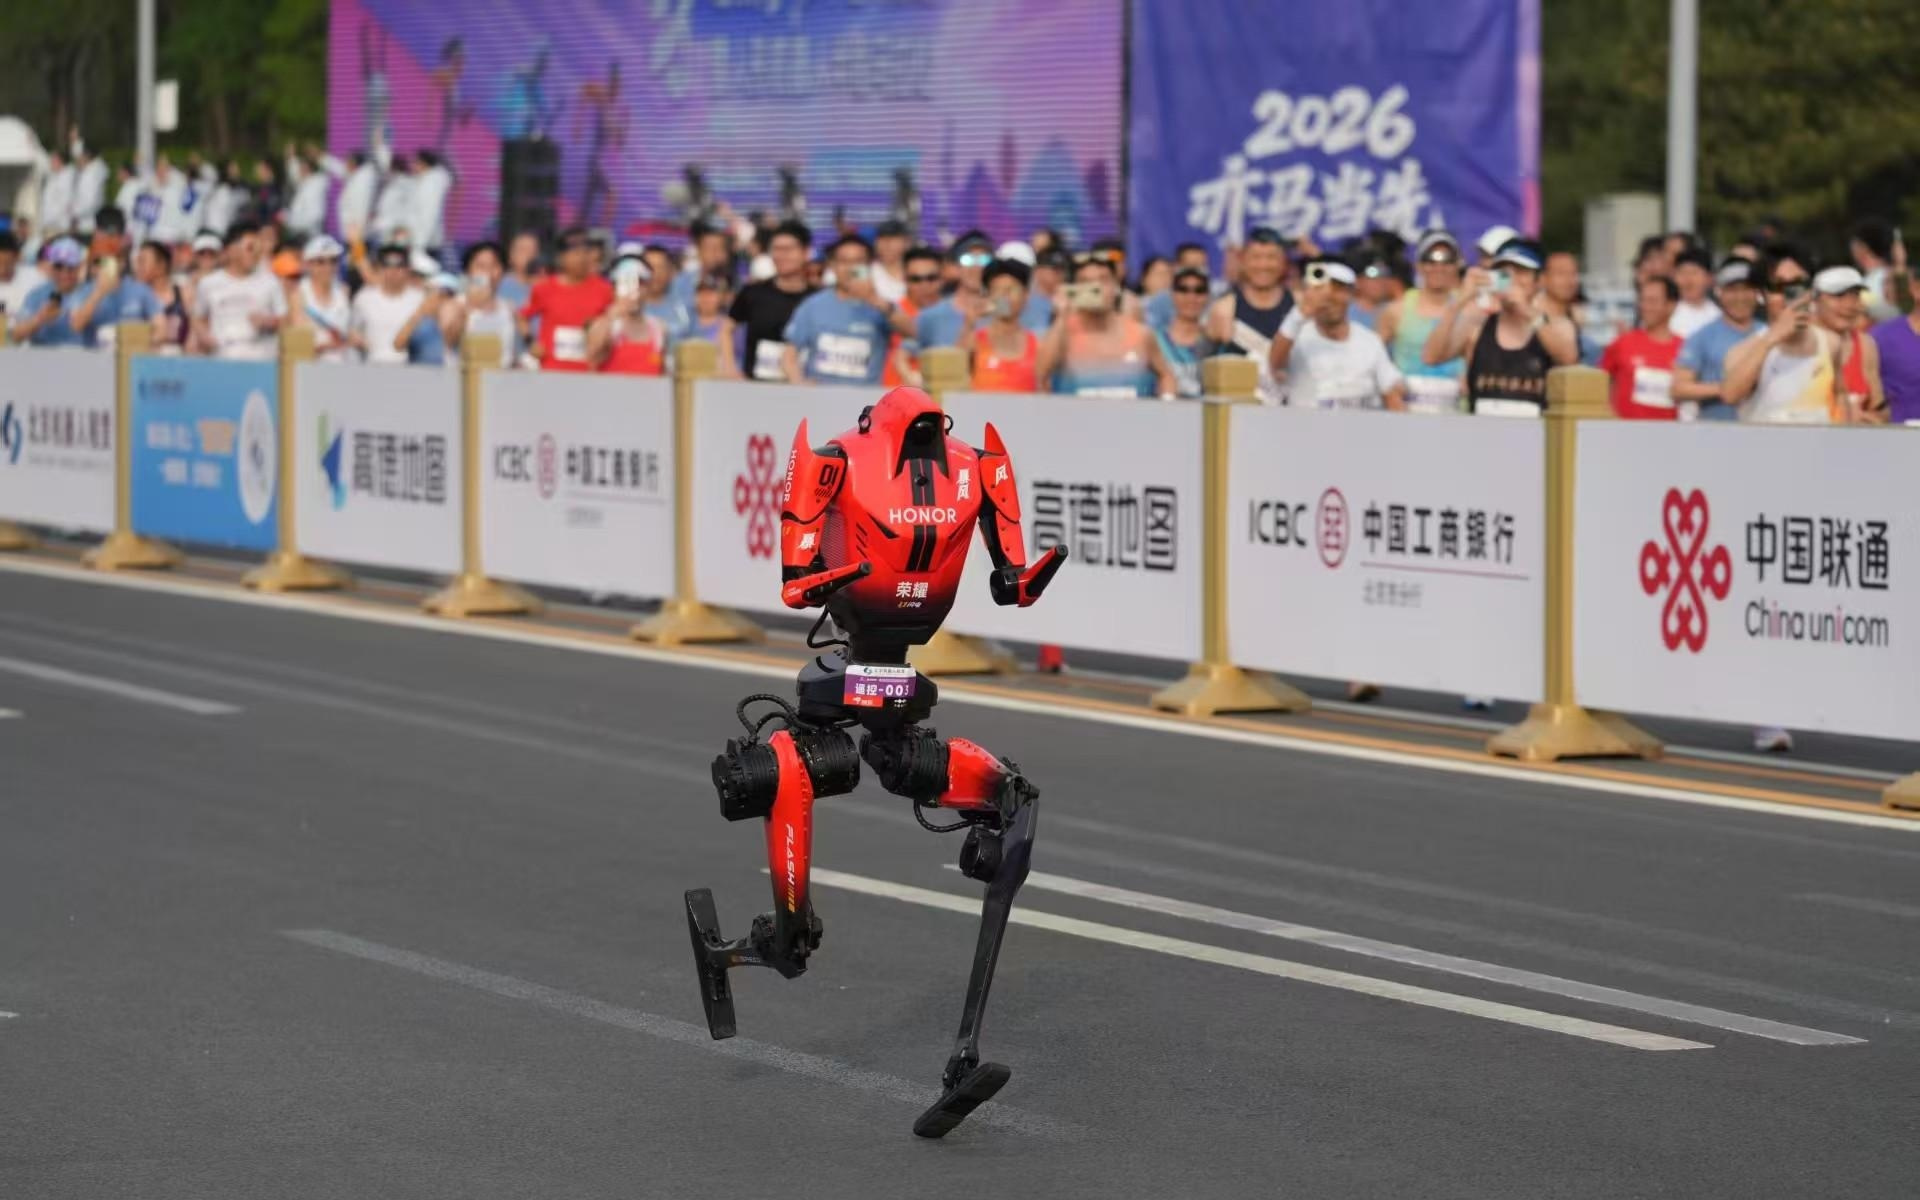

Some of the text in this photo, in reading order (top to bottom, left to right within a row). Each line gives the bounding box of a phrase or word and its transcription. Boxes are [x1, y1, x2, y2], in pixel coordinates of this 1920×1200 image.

[1244, 84, 1416, 159] 2026
[1187, 154, 1446, 250] 亦马当先
[494, 445, 532, 482] ICBC
[784, 450, 798, 503] HONOR
[889, 507, 958, 524] HONOR
[1033, 481, 1177, 571] 高德地图
[1249, 500, 1308, 547] ICBC
[1362, 501, 1516, 564] 中国工商银行
[1746, 513, 1890, 590] 中国联通
[896, 581, 930, 599] 荣耀
[1745, 598, 1890, 647] China unicom
[785, 823, 796, 886] FLASH
